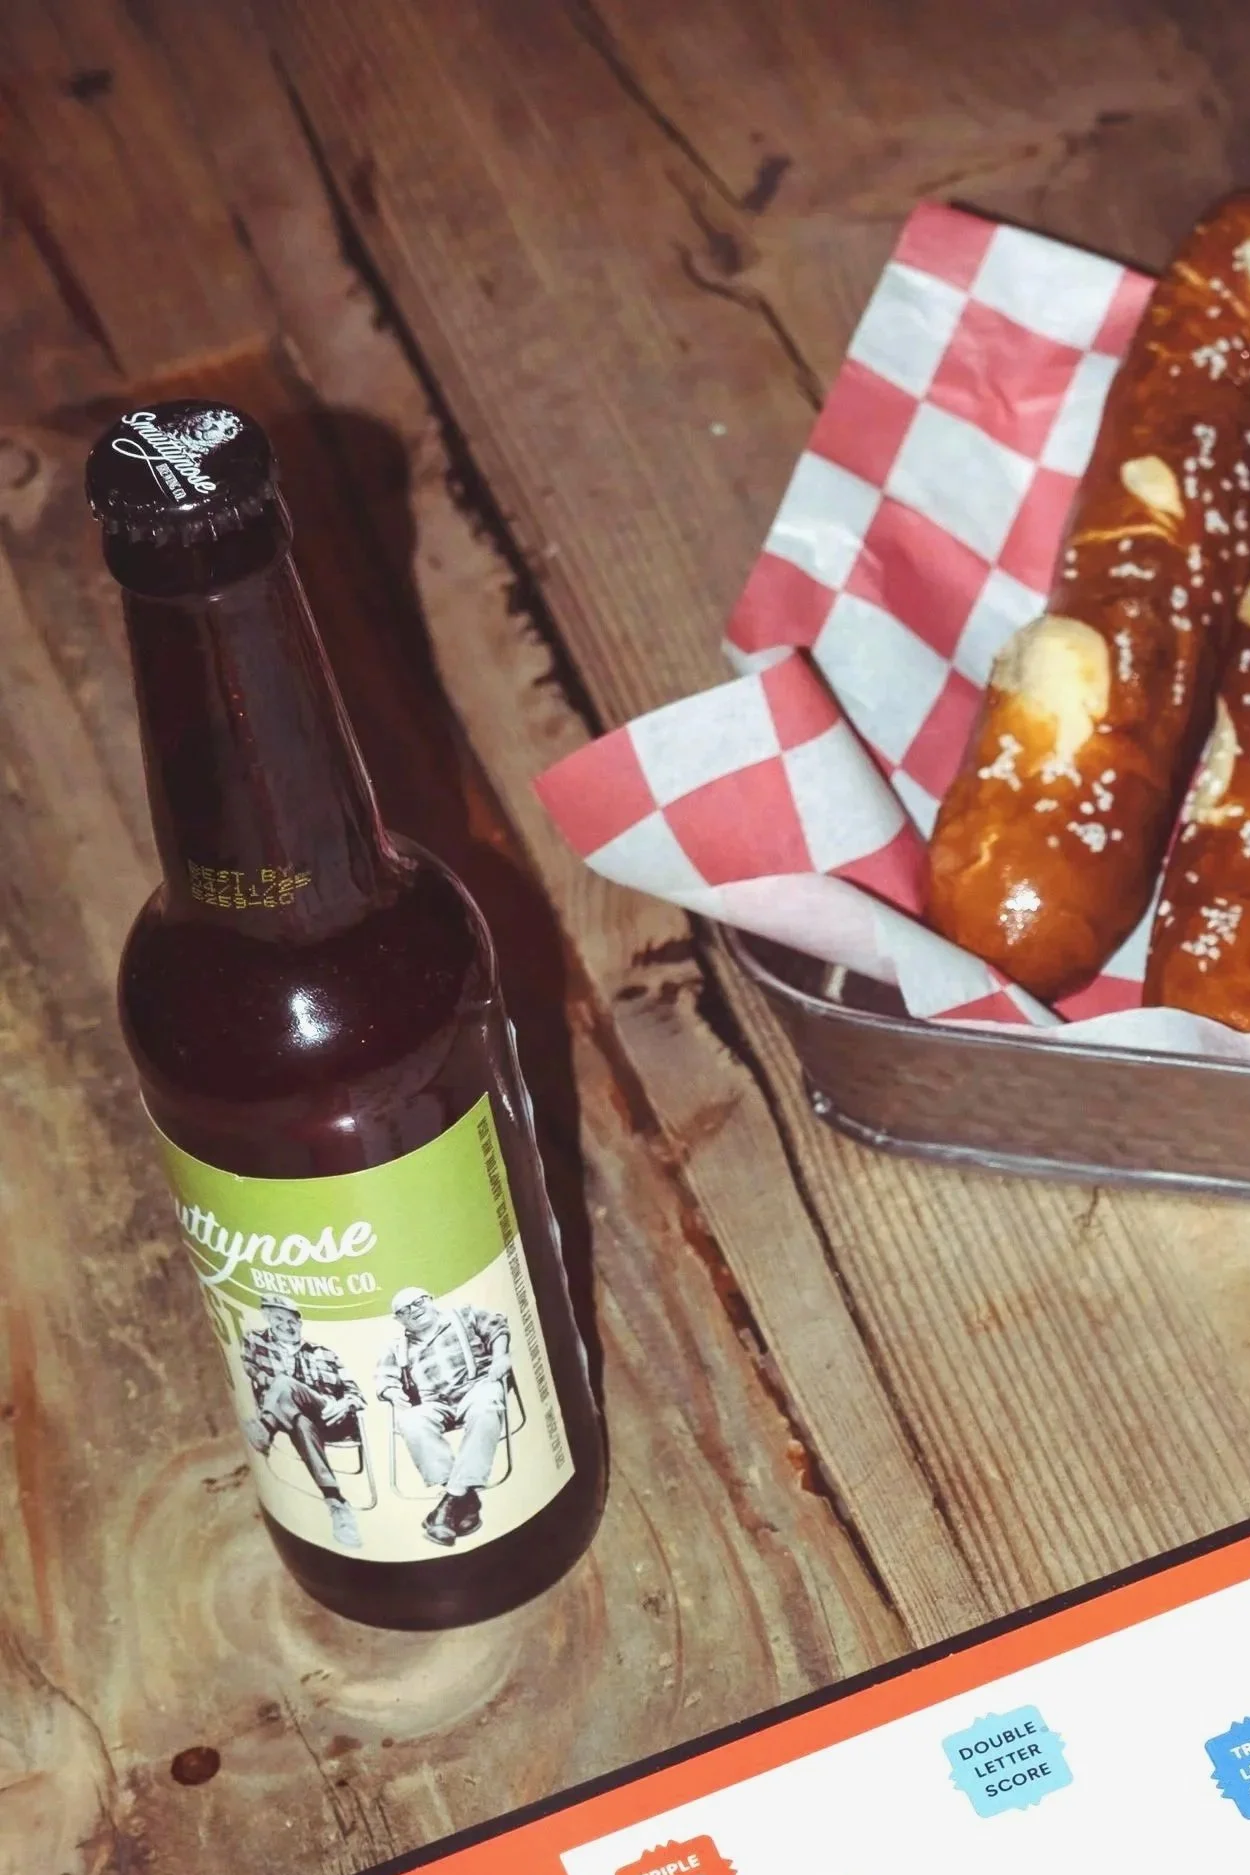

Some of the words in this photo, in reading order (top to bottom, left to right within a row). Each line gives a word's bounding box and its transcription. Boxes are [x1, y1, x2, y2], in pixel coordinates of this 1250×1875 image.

[250, 1268, 345, 1297] BREWING
[346, 1271, 383, 1296] CO.
[958, 1721, 1037, 1761] DOUBLE
[974, 1743, 1042, 1778] LETTER
[985, 1762, 1052, 1798] SCORE
